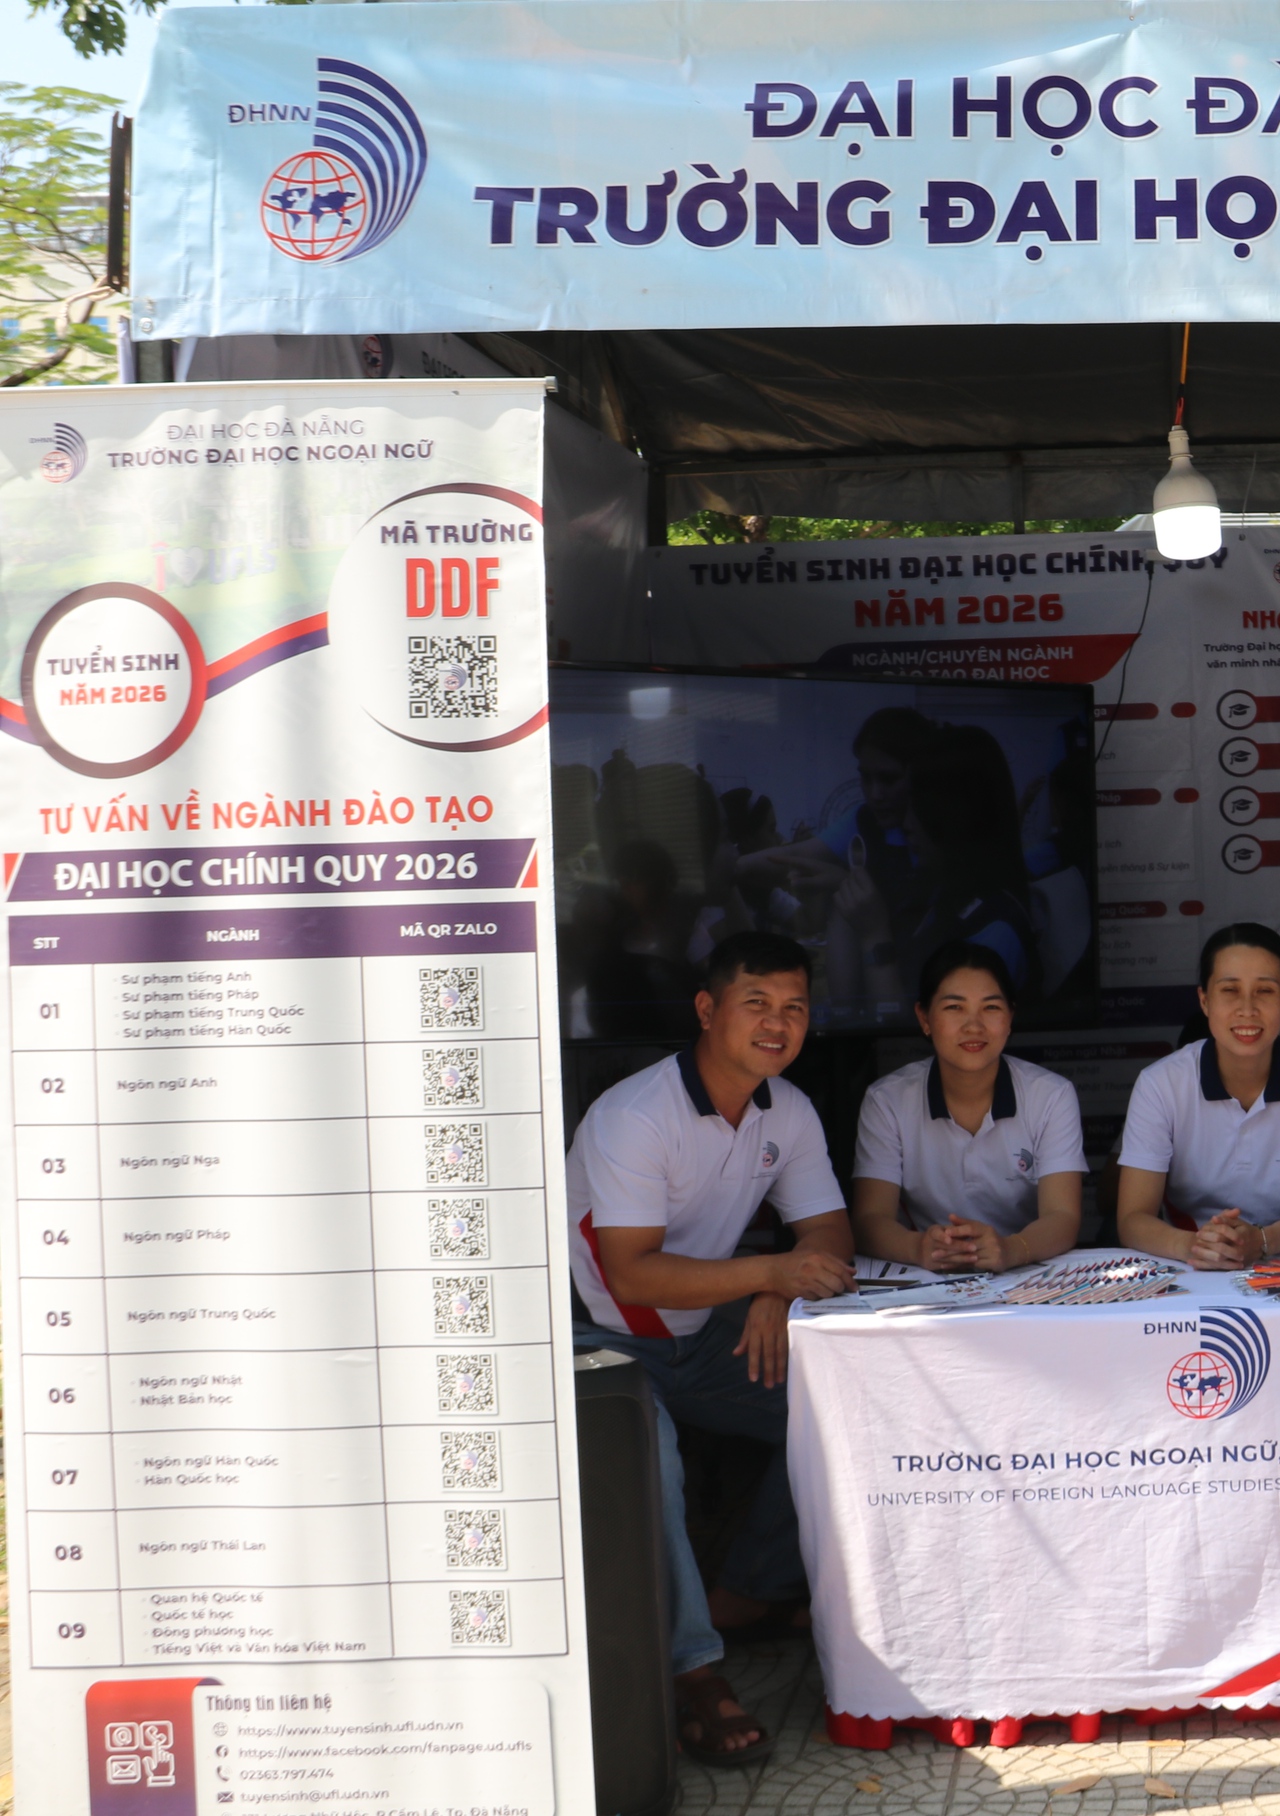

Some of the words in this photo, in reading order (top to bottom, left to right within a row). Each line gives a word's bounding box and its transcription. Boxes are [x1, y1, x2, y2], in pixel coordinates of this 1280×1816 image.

[227, 103, 311, 124] ĐHNN
[745, 80, 912, 155] ĐẠI
[953, 76, 1158, 156] HỌC
[475, 164, 890, 247] TRƯỜNG
[920, 180, 1097, 260] ĐẠI
[167, 423, 205, 443] ĐẠI
[211, 420, 259, 441] HỌC
[264, 418, 297, 438] ĐÀ
[302, 414, 365, 437] NẴNG
[106, 449, 198, 469] TRƯỜNG
[204, 447, 244, 468] ĐẠI
[252, 445, 301, 466] HỌC
[307, 443, 376, 463] NGOẠI
[384, 439, 434, 459] NGỮ
[381, 521, 418, 544] MÃ
[431, 518, 533, 543] TRƯỜNG
[690, 547, 797, 586] TUYỂN
[806, 556, 890, 582] SINH
[899, 555, 963, 585] ĐẠI
[973, 552, 1037, 583] HỌC
[405, 557, 501, 618] DDF
[854, 589, 945, 626] NĂM
[958, 594, 1063, 624] 2026
[47, 644, 117, 676] TUYỂN
[122, 653, 181, 673] SINH
[852, 645, 1002, 666] NGÀNH/CHUYÊN
[1007, 643, 1074, 662] NGÀNH
[59, 683, 105, 706] NĂM
[111, 684, 167, 704] 2026
[40, 804, 73, 834] TƯ
[84, 793, 148, 832] VẤN
[161, 790, 200, 830] VỀ
[213, 794, 330, 828] NGÀNH
[343, 790, 414, 825] ĐÀO
[426, 795, 492, 830] TẠO
[54, 862, 110, 897] ĐẠI
[118, 860, 193, 895] HỌC
[200, 854, 304, 886] CHÍNH
[315, 854, 388, 886] QUY
[395, 853, 477, 880] 2026
[206, 926, 260, 943] NGÀNH
[399, 921, 426, 937] MÃ
[427, 923, 452, 939] QR
[453, 922, 498, 936] ZALO
[33, 936, 61, 950] STT
[39, 1003, 59, 1020] 01
[41, 1077, 65, 1094] 02
[41, 1157, 66, 1175] 03
[42, 1229, 70, 1246] 04
[46, 1311, 72, 1327] 05
[1143, 1320, 1197, 1335] ĐHNN
[48, 1387, 75, 1404] 06
[891, 1450, 1002, 1473] TRƯỜNG
[1010, 1452, 1055, 1471] ĐẠI
[1065, 1450, 1121, 1469] HỌC
[1130, 1446, 1212, 1468] NGOẠI
[51, 1469, 79, 1486] 07
[867, 1490, 975, 1507] UNIVERSITY
[980, 1488, 1007, 1503] OF
[1011, 1486, 1094, 1503] FOREIGN
[1101, 1480, 1202, 1499] LANGUAGE
[54, 1545, 83, 1561] 08
[57, 1623, 86, 1639] 09
